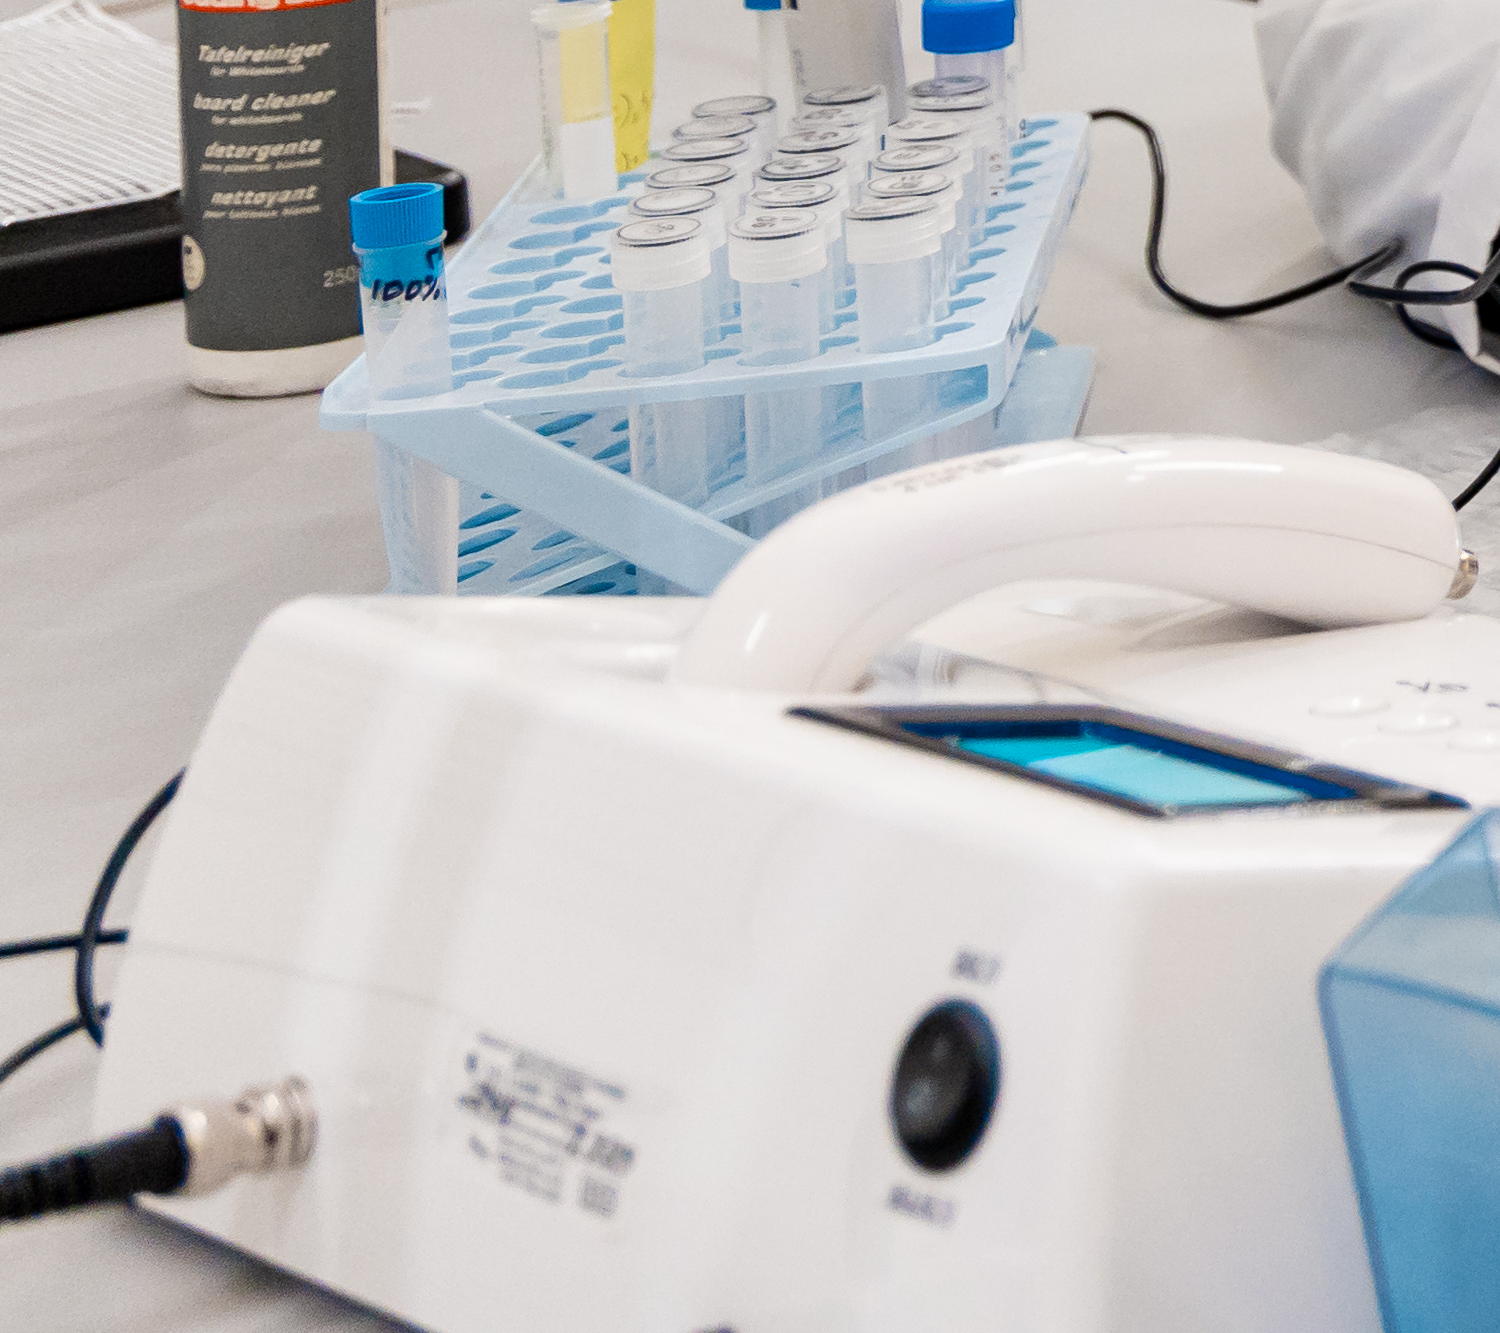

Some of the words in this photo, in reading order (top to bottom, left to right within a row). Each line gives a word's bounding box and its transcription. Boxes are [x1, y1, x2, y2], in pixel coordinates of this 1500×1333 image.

[199, 42, 331, 64] Tafelreiniger
[193, 92, 249, 112] board
[251, 89, 338, 111] cleaner
[205, 138, 324, 163] detergente
[211, 185, 319, 208] nettoyant
[371, 276, 441, 302] 100%
